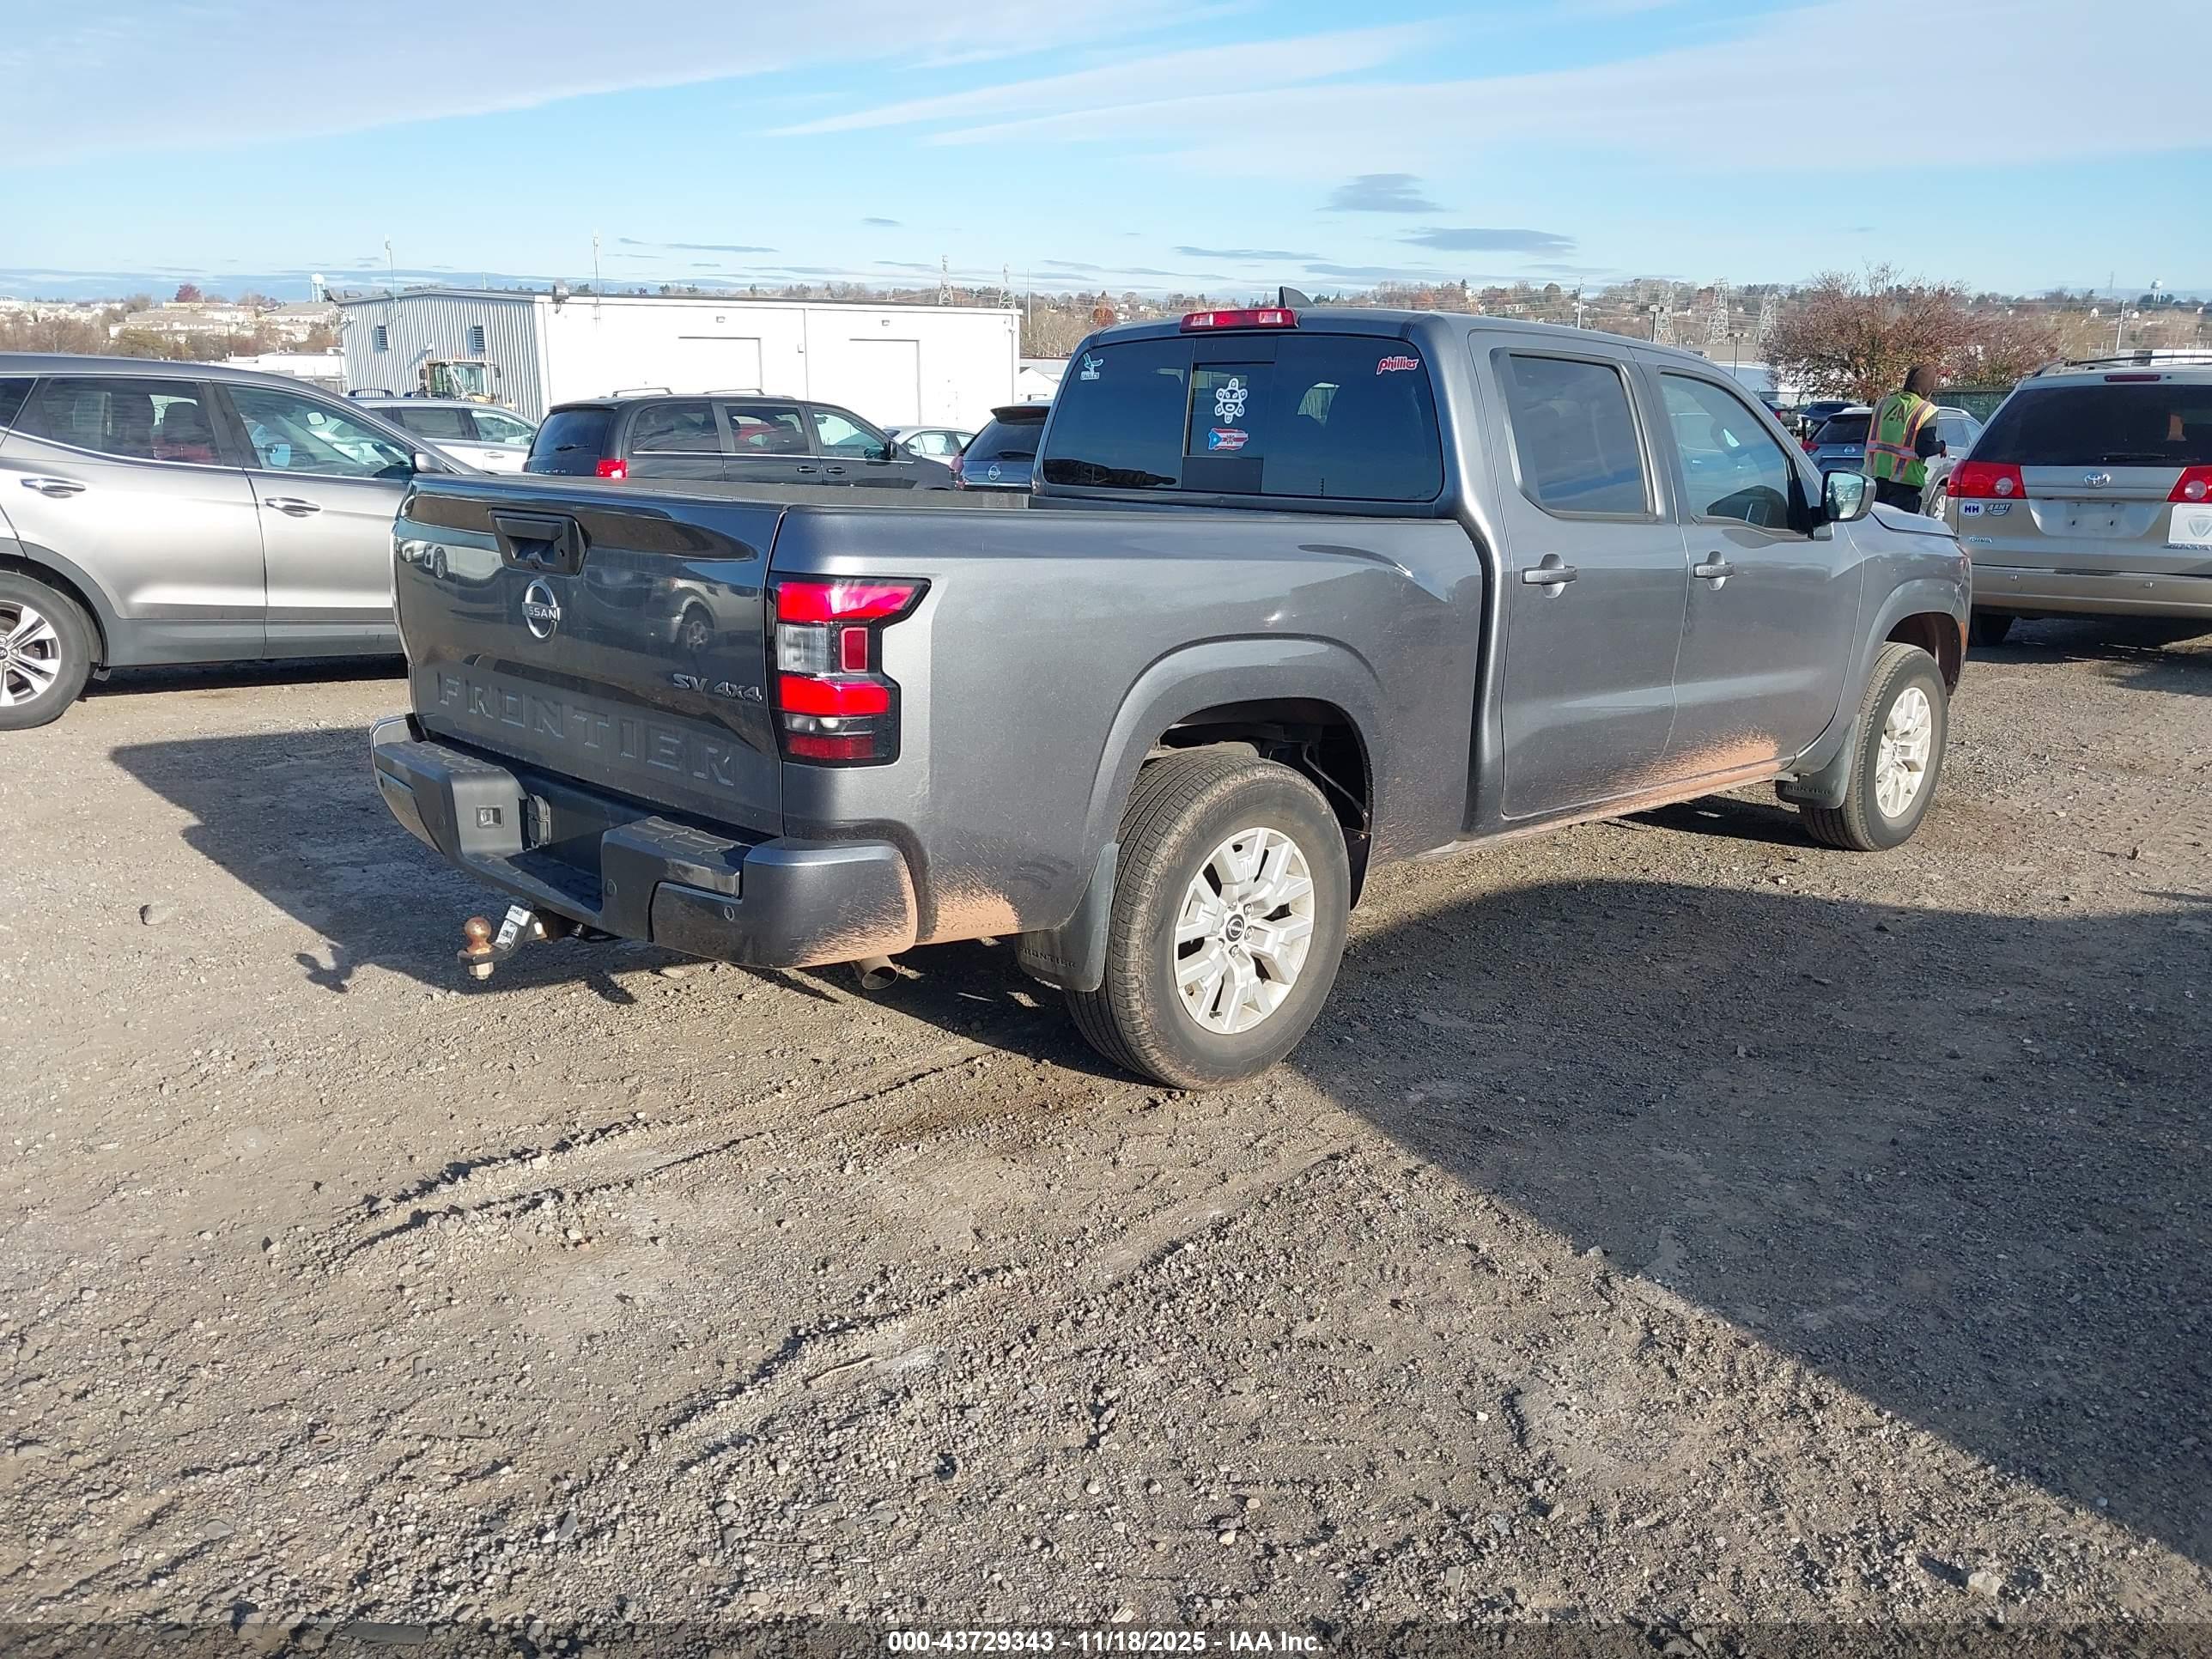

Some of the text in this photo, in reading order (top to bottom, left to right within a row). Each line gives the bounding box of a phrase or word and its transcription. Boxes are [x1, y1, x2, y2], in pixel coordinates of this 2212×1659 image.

[1965, 505, 1979, 514] HH
[522, 603, 558, 621] SSAN
[672, 673, 708, 694] SV
[437, 671, 735, 787] FRONTIER
